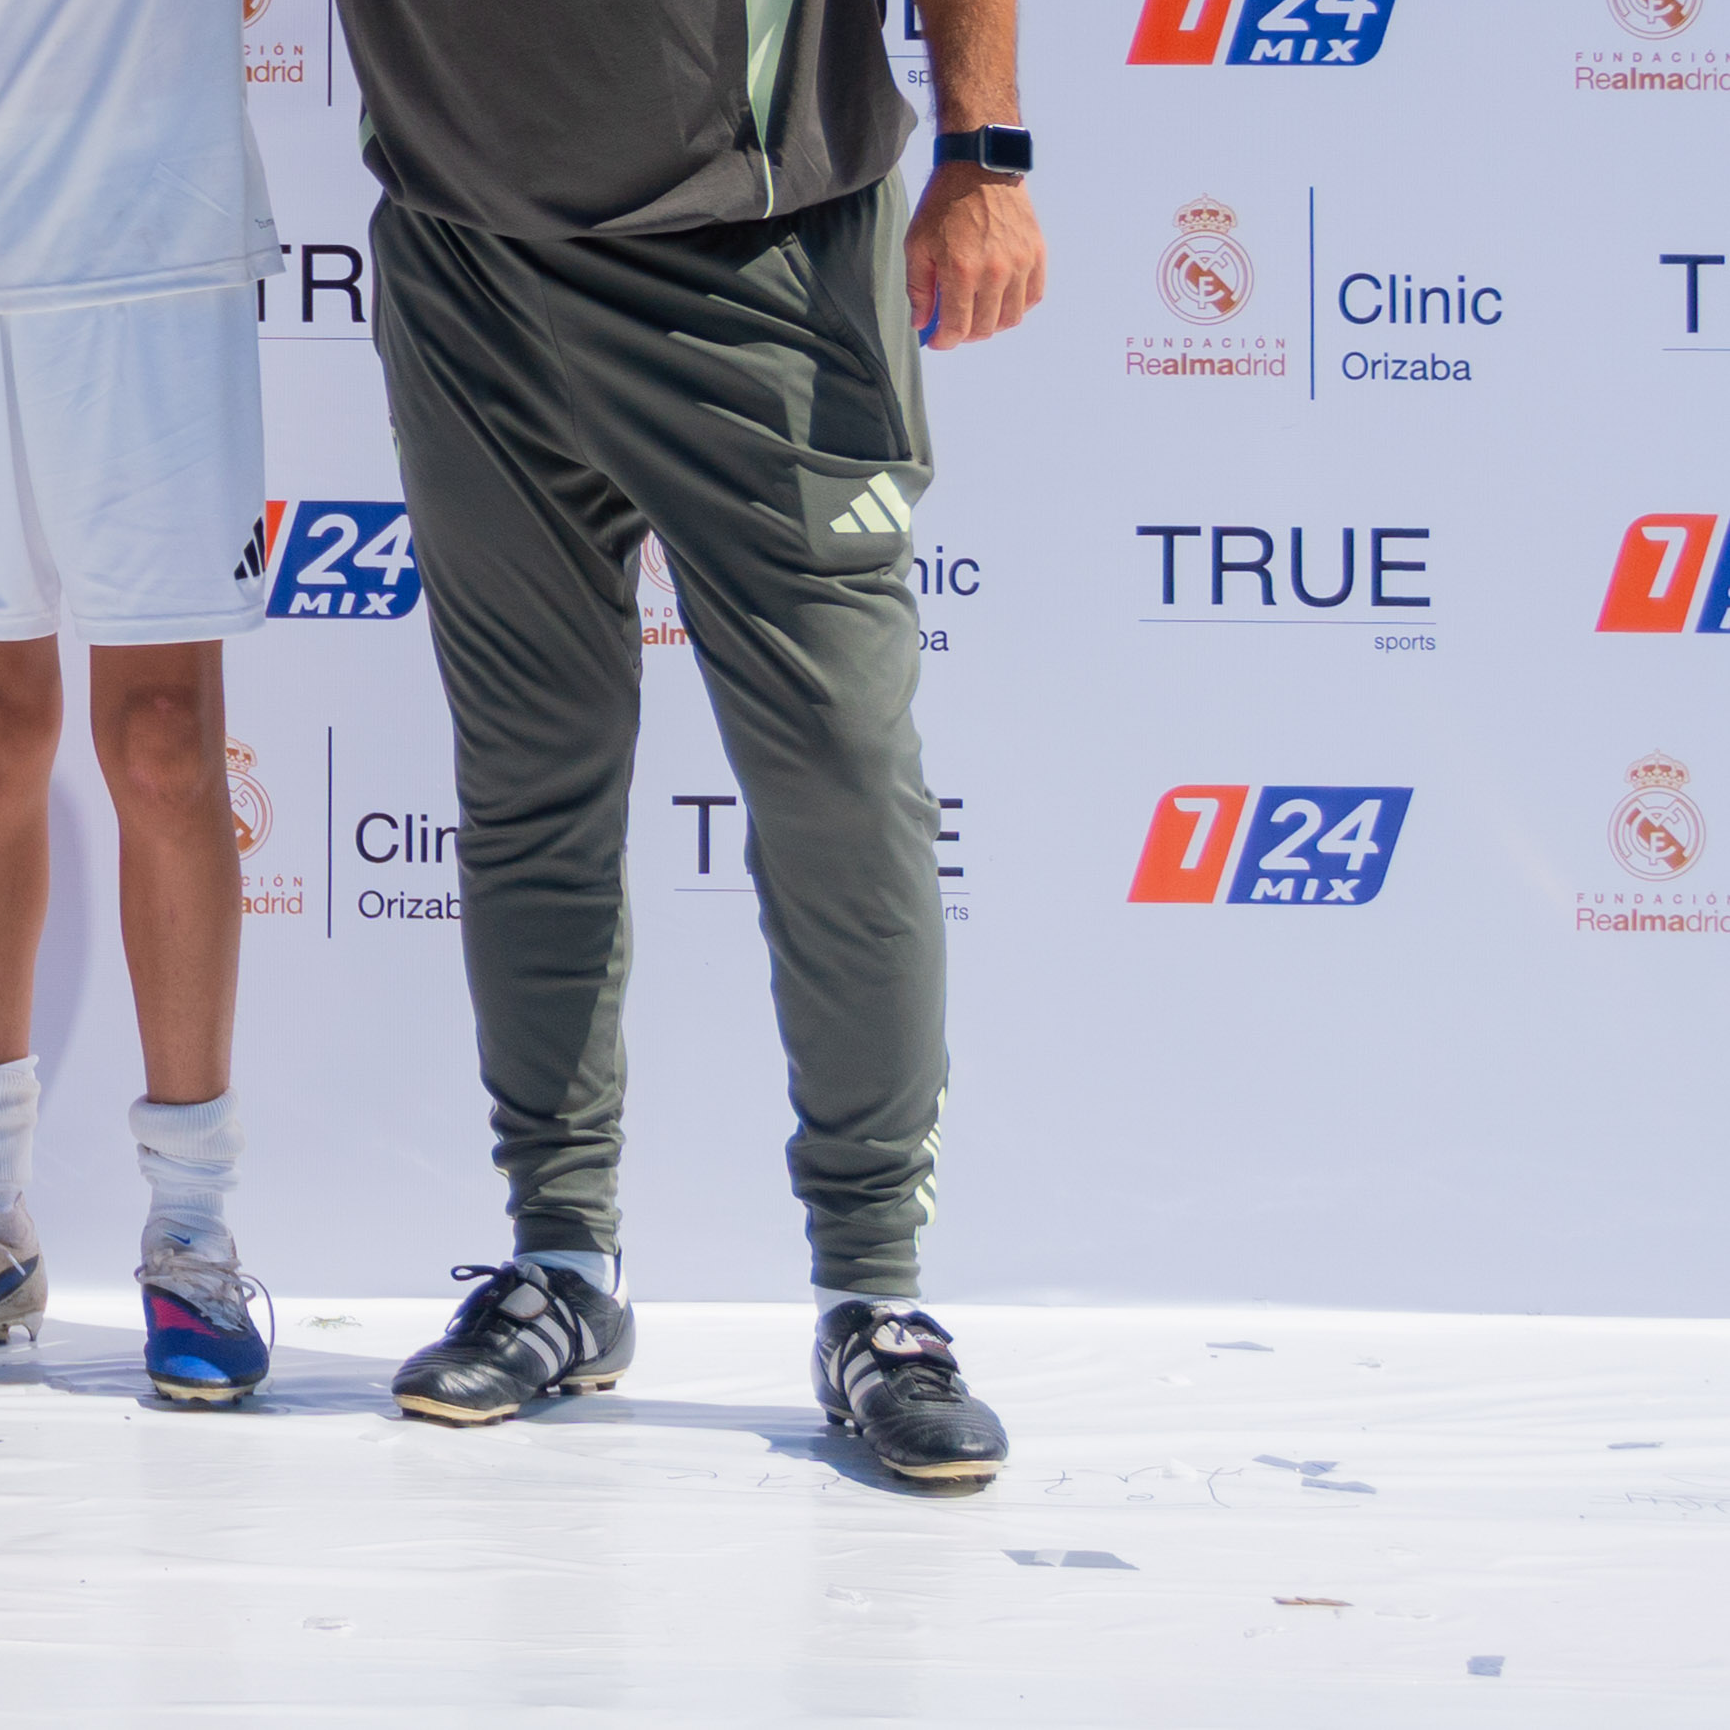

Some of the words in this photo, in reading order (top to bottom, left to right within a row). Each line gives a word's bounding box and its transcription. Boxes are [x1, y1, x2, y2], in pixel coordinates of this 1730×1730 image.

[1248, 39, 1361, 62] MIX
[1338, 273, 1504, 326] Clinic
[1126, 336, 1287, 349] FUNDACIÓN
[1126, 351, 1287, 377] Realmadrid
[1341, 352, 1472, 382] Orizaba
[296, 513, 415, 586] 24
[1136, 526, 1431, 608] TRUE
[288, 592, 397, 616] MIX
[1374, 632, 1436, 654] sports
[1259, 799, 1381, 872] 24
[1250, 879, 1363, 902] MIX
[357, 890, 461, 920] Orizab
